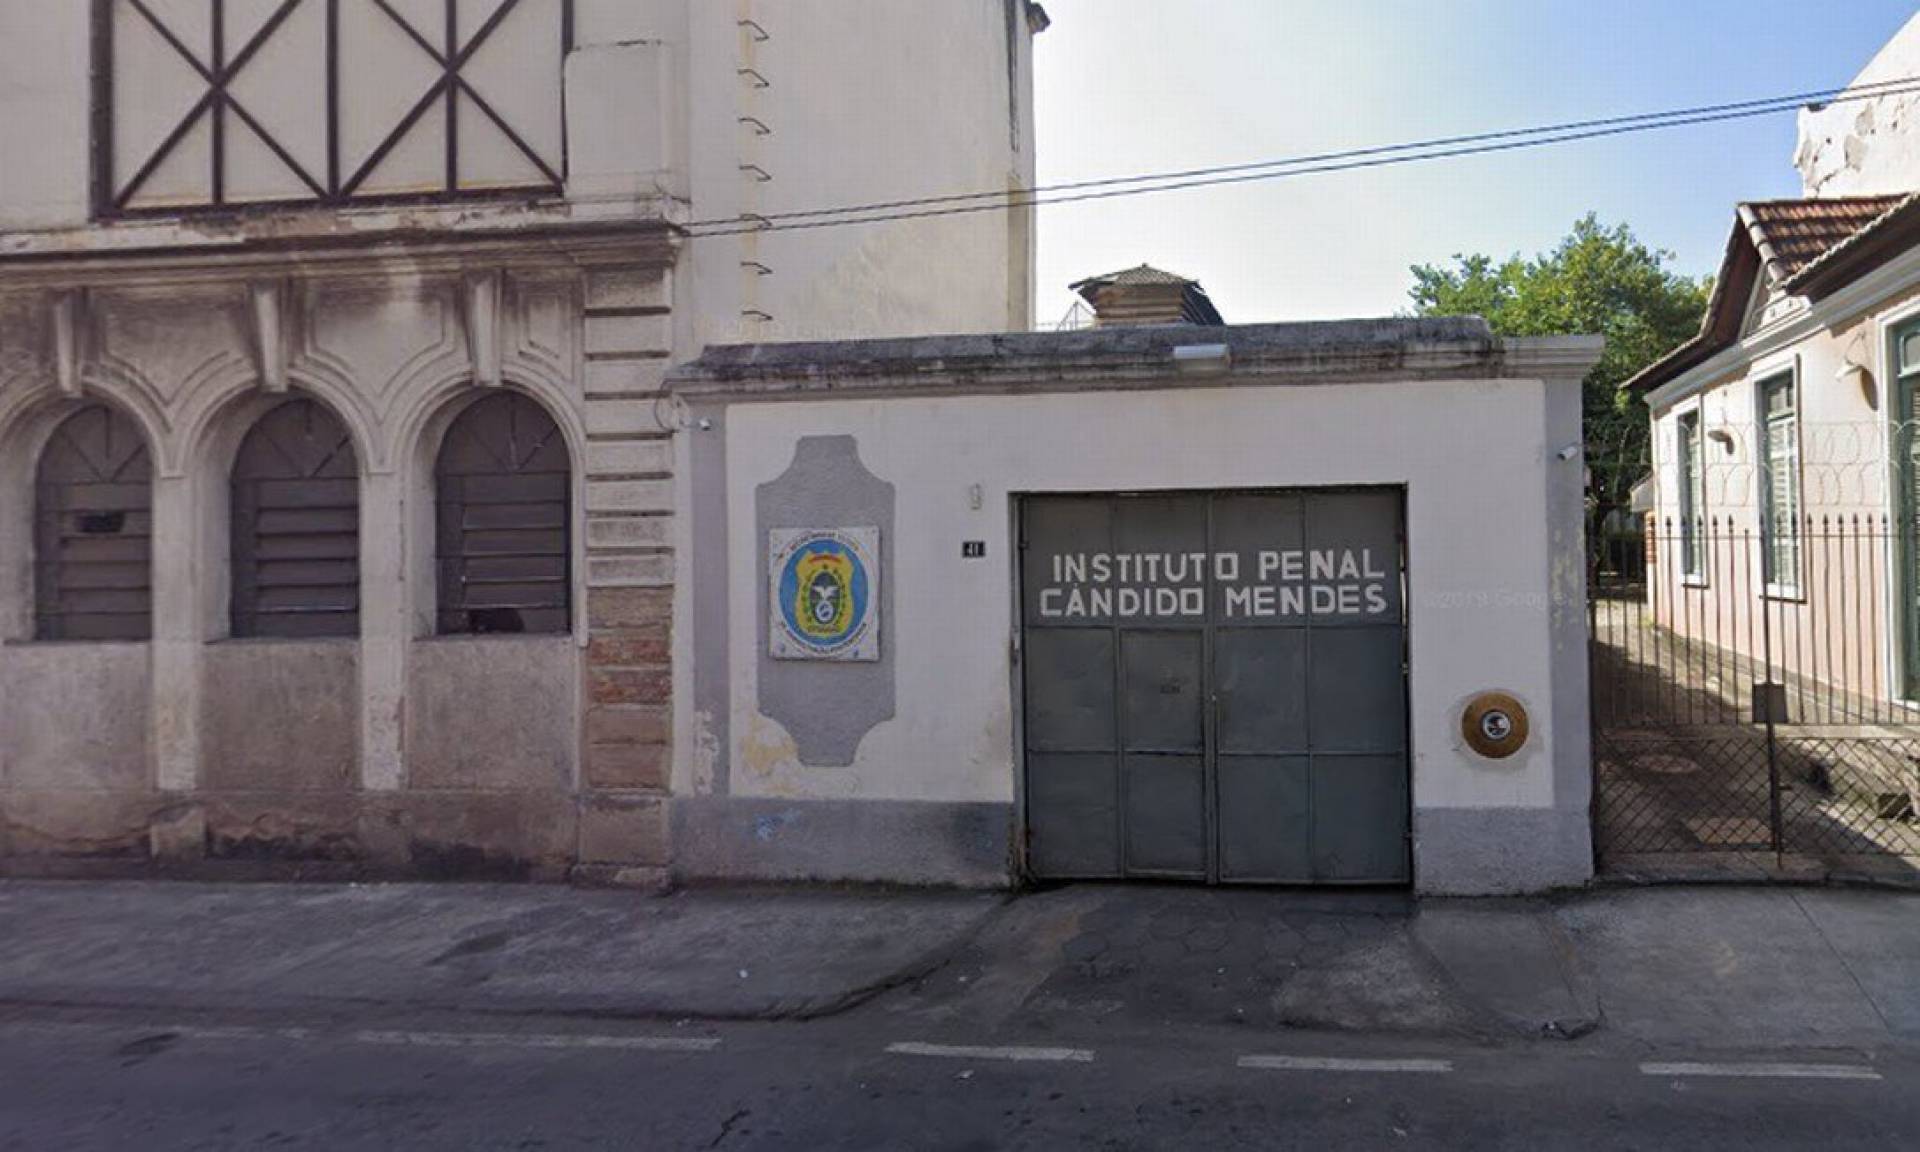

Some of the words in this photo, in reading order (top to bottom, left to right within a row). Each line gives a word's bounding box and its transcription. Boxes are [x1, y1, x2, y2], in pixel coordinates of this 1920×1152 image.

[1053, 552, 1239, 582] INSTITUTO
[1259, 548, 1385, 580] PENAL
[1226, 585, 1388, 617] MENDES
